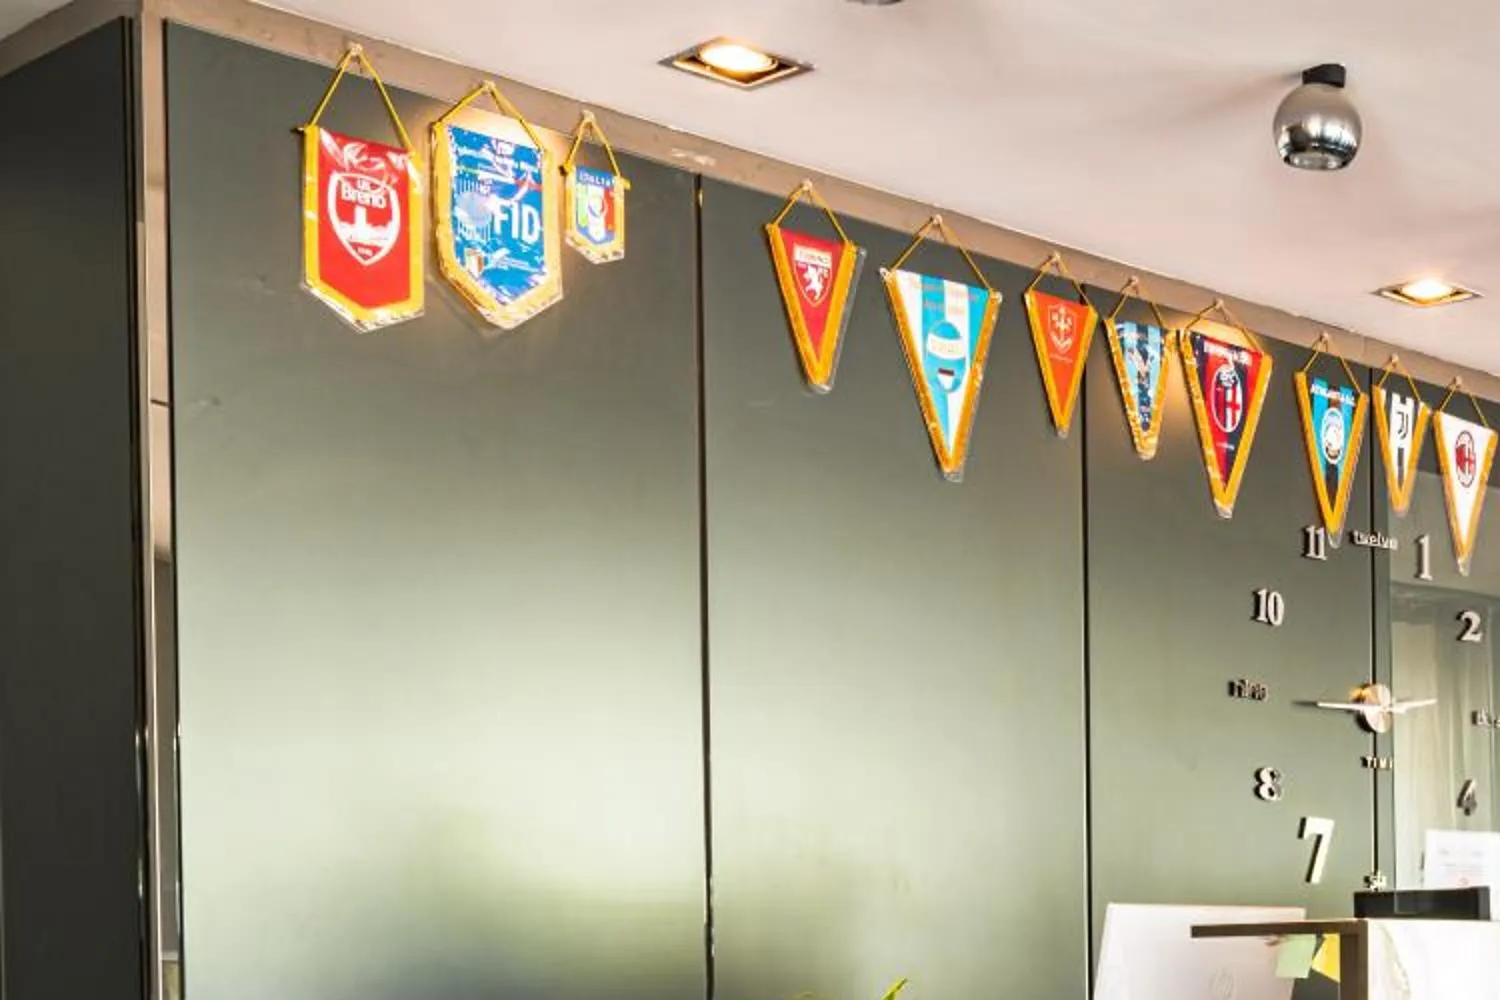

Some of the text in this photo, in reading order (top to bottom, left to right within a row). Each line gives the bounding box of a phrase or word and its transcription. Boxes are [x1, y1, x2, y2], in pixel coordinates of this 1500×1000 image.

[1304, 525, 1327, 561] 11
[1352, 530, 1399, 550] twelve
[1418, 533, 1433, 581] 1
[1255, 588, 1285, 627] 10
[1459, 611, 1482, 642] 2
[1257, 767, 1284, 802] 8
[1459, 779, 1478, 815] 4
[1300, 817, 1335, 885] 7
